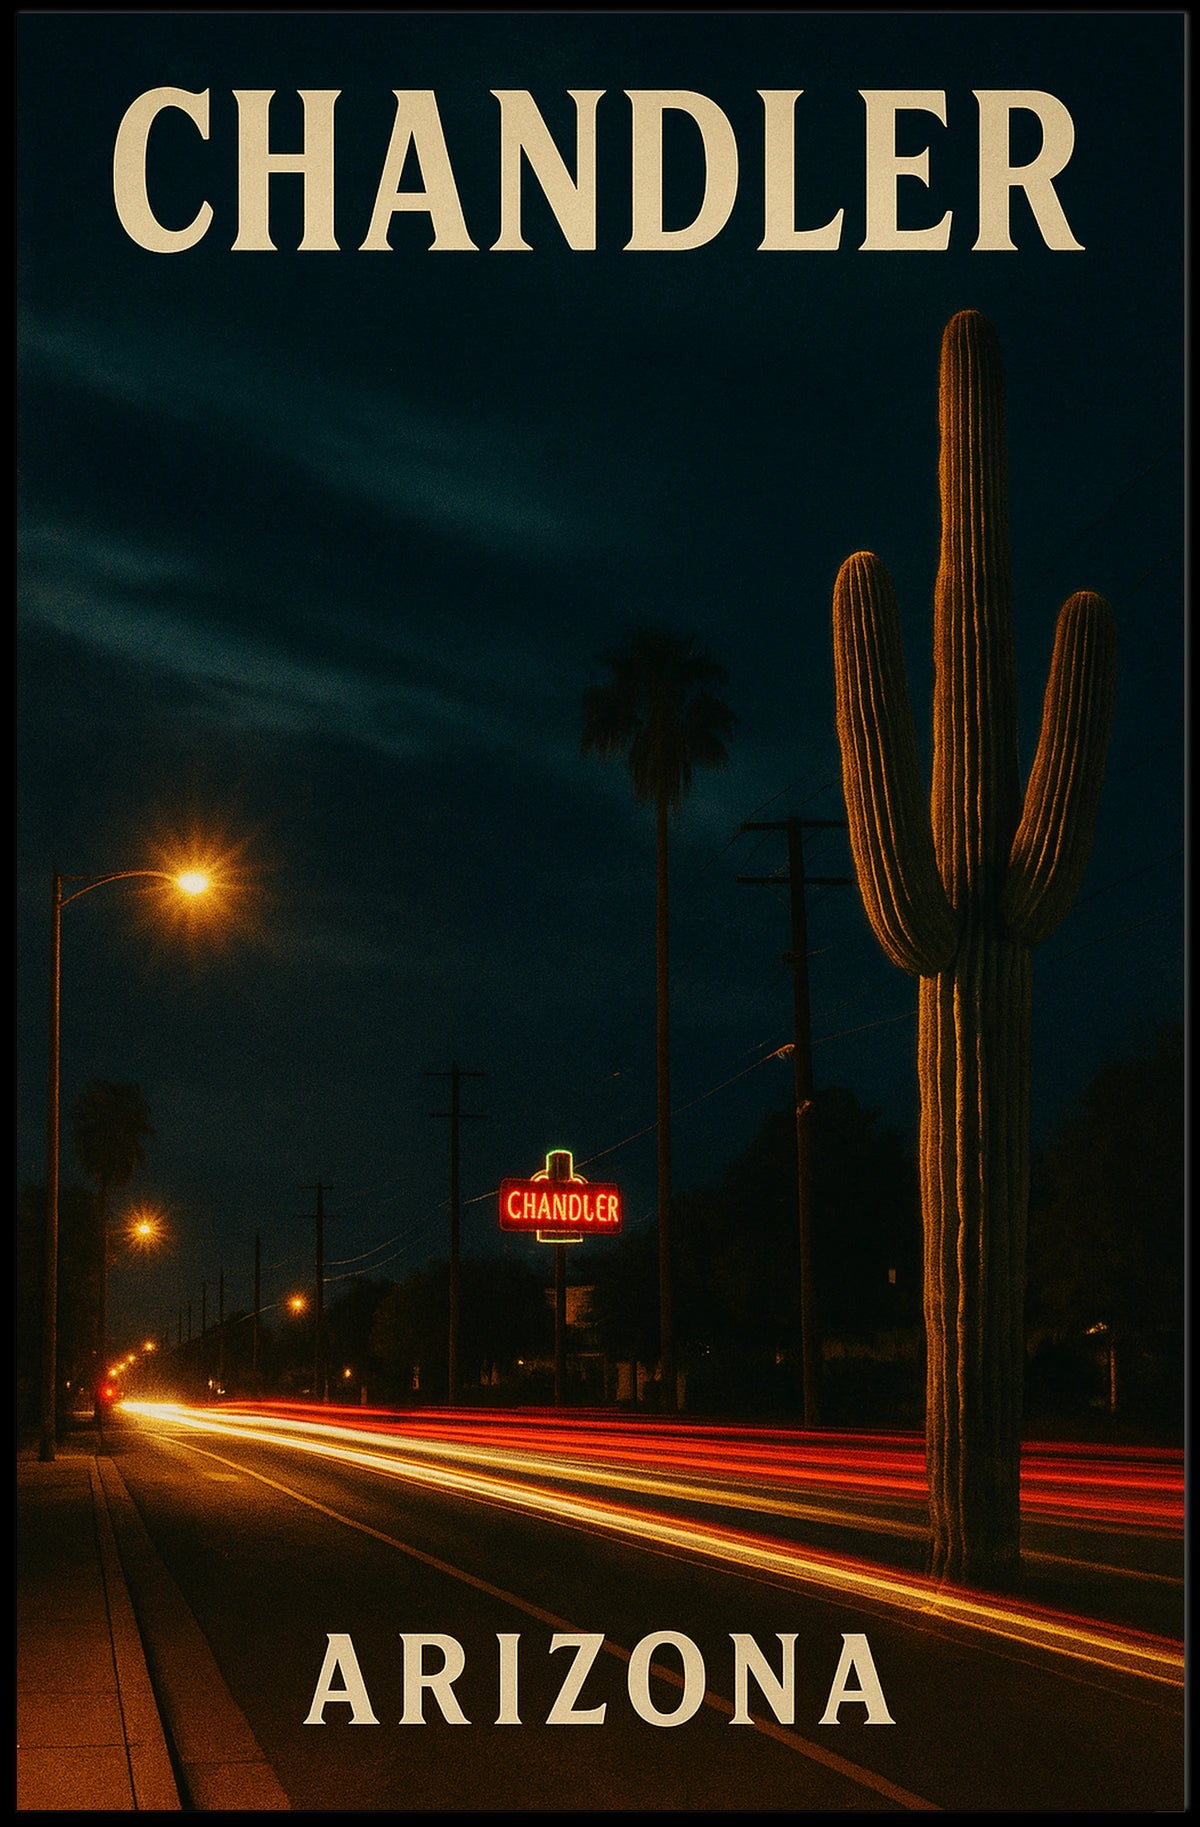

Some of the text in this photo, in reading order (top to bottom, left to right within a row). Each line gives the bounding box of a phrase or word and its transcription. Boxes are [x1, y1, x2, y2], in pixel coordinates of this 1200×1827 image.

[113, 86, 1086, 254] CHANDLER
[507, 1190, 619, 1222] CHANDLER
[302, 1630, 897, 1728] ARIZONA
